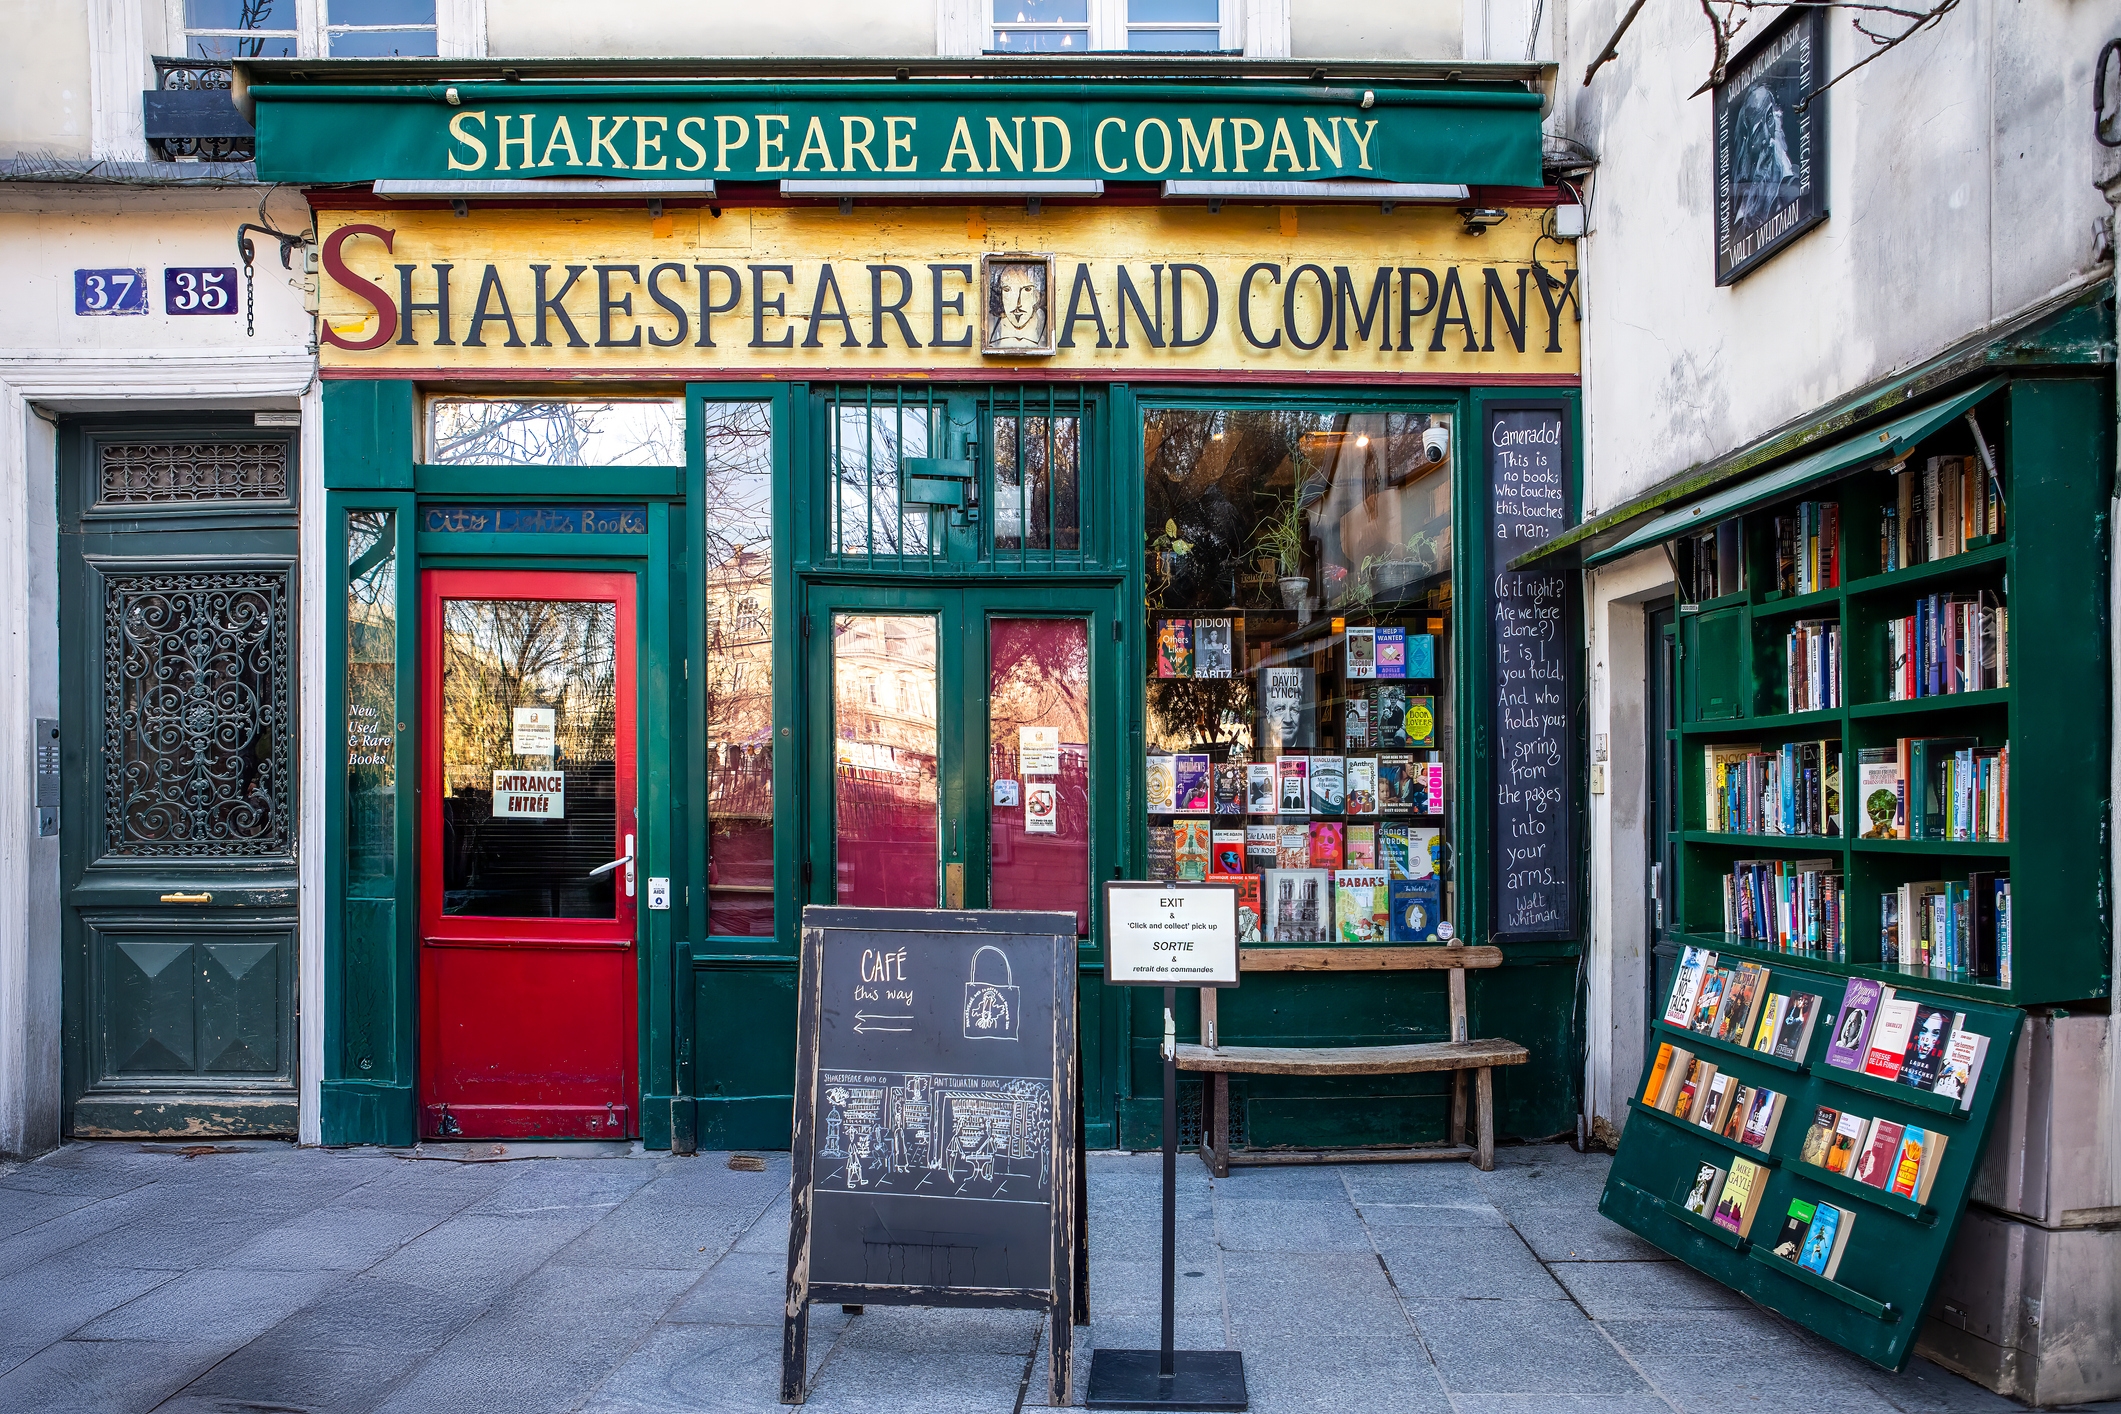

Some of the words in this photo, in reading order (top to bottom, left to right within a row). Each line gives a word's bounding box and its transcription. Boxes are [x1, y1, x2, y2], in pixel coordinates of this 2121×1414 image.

[1781, 23, 1800, 55] DESIR
[448, 111, 917, 173] SHAKESPEARE
[940, 116, 1071, 173] AND
[1094, 117, 1378, 174] COMPANY
[1800, 131, 1811, 196] REGARDE
[1720, 174, 1730, 197] QUI
[1728, 232, 1754, 269] WALT
[1756, 199, 1801, 251] WHITMAN
[85, 273, 136, 310] 37
[174, 271, 229, 310] 35
[320, 224, 973, 352] SHAKESPEARE
[1057, 262, 1219, 349] AND
[1238, 262, 1579, 353] COMPANY
[1492, 420, 1561, 448] Camerado!
[1498, 451, 1529, 468] This
[1536, 451, 1548, 467] is
[1504, 471, 1519, 482] no
[1523, 468, 1559, 484] book;
[1495, 483, 1518, 497] Who
[1520, 483, 1562, 500] touches
[1496, 500, 1521, 516] this,
[1521, 501, 1563, 519] touches
[428, 509, 489, 533] City
[495, 509, 574, 533] Lights
[581, 510, 645, 534] Books
[1497, 524, 1508, 539] a
[1515, 523, 1550, 538] man;
[1494, 573, 1509, 599] (Is
[1513, 574, 1523, 597] it
[1526, 576, 1564, 605] night?
[1495, 602, 1516, 621] Are
[1518, 608, 1533, 619] we
[1533, 604, 1560, 620] here
[1194, 618, 1231, 628] DIDION
[1503, 620, 1555, 642] alone?)
[1162, 635, 1189, 644] Others
[1168, 645, 1184, 653] Like
[1222, 643, 1231, 655] &
[1498, 643, 1510, 664] It
[1519, 643, 1532, 661] is
[1540, 640, 1546, 662] I
[1169, 655, 1183, 663] Me
[1356, 667, 1368, 677] 19
[1500, 668, 1526, 687] you
[1529, 659, 1564, 682] hold,
[1272, 675, 1299, 687] DAVID
[1271, 687, 1300, 699] LYNCH
[1498, 686, 1529, 707] And
[1535, 684, 1560, 704] who
[348, 704, 377, 719] New,
[1409, 711, 1430, 719] BOOK
[348, 721, 379, 733] Used
[1406, 718, 1433, 727] LOVERS
[1504, 708, 1539, 730] holds
[1542, 713, 1566, 737] you;
[348, 735, 359, 746] &
[362, 735, 391, 746] Rare
[348, 753, 386, 765] Books
[1500, 736, 1506, 759] I
[1514, 737, 1561, 766] spring
[1509, 758, 1546, 785] from
[495, 775, 562, 793] ENTRANCE
[1429, 767, 1443, 808] HOPE
[508, 793, 549, 812] ENTRÉE
[1498, 784, 1521, 805] the
[1525, 787, 1561, 813] pages
[1378, 828, 1406, 836] CHOICE
[1511, 813, 1546, 837] into
[1379, 837, 1406, 845] WORDS
[1506, 843, 1546, 870] your
[1339, 876, 1385, 888] BABAR'S
[1507, 868, 1565, 890] arms...
[1159, 898, 1185, 908] EXIT
[1516, 892, 1546, 911] Walt
[1169, 912, 1175, 920] &
[1508, 908, 1559, 926] Whitman
[1191, 923, 1207, 931] pick
[1152, 941, 1195, 951] SORTIE
[861, 946, 907, 982] CAFÉ
[1171, 955, 1177, 963] &
[1678, 965, 1694, 983] TELL
[854, 984, 879, 1001] this
[886, 989, 914, 1005] way
[1676, 981, 1688, 997] NO
[1669, 994, 1690, 1014] TALES
[1870, 1051, 1892, 1061] IVRESSE
[1909, 1059, 1930, 1069] LAURA
[1882, 1061, 1900, 1071] FUGUE
[1900, 1066, 1934, 1080] KASISCHKE
[823, 1073, 862, 1083] SHAKESPEARE
[864, 1075, 878, 1084] AND
[878, 1076, 887, 1084] CO
[933, 1077, 979, 1088] ANTIQUARIAN
[981, 1079, 1000, 1089] BOOKS
[1818, 1110, 1833, 1120] SADE
[1735, 1163, 1752, 1176] MIKE
[1727, 1172, 1752, 1192] GAYLE
[1713, 1216, 1722, 1226] HIS
[1726, 1222, 1738, 1233] HERS
